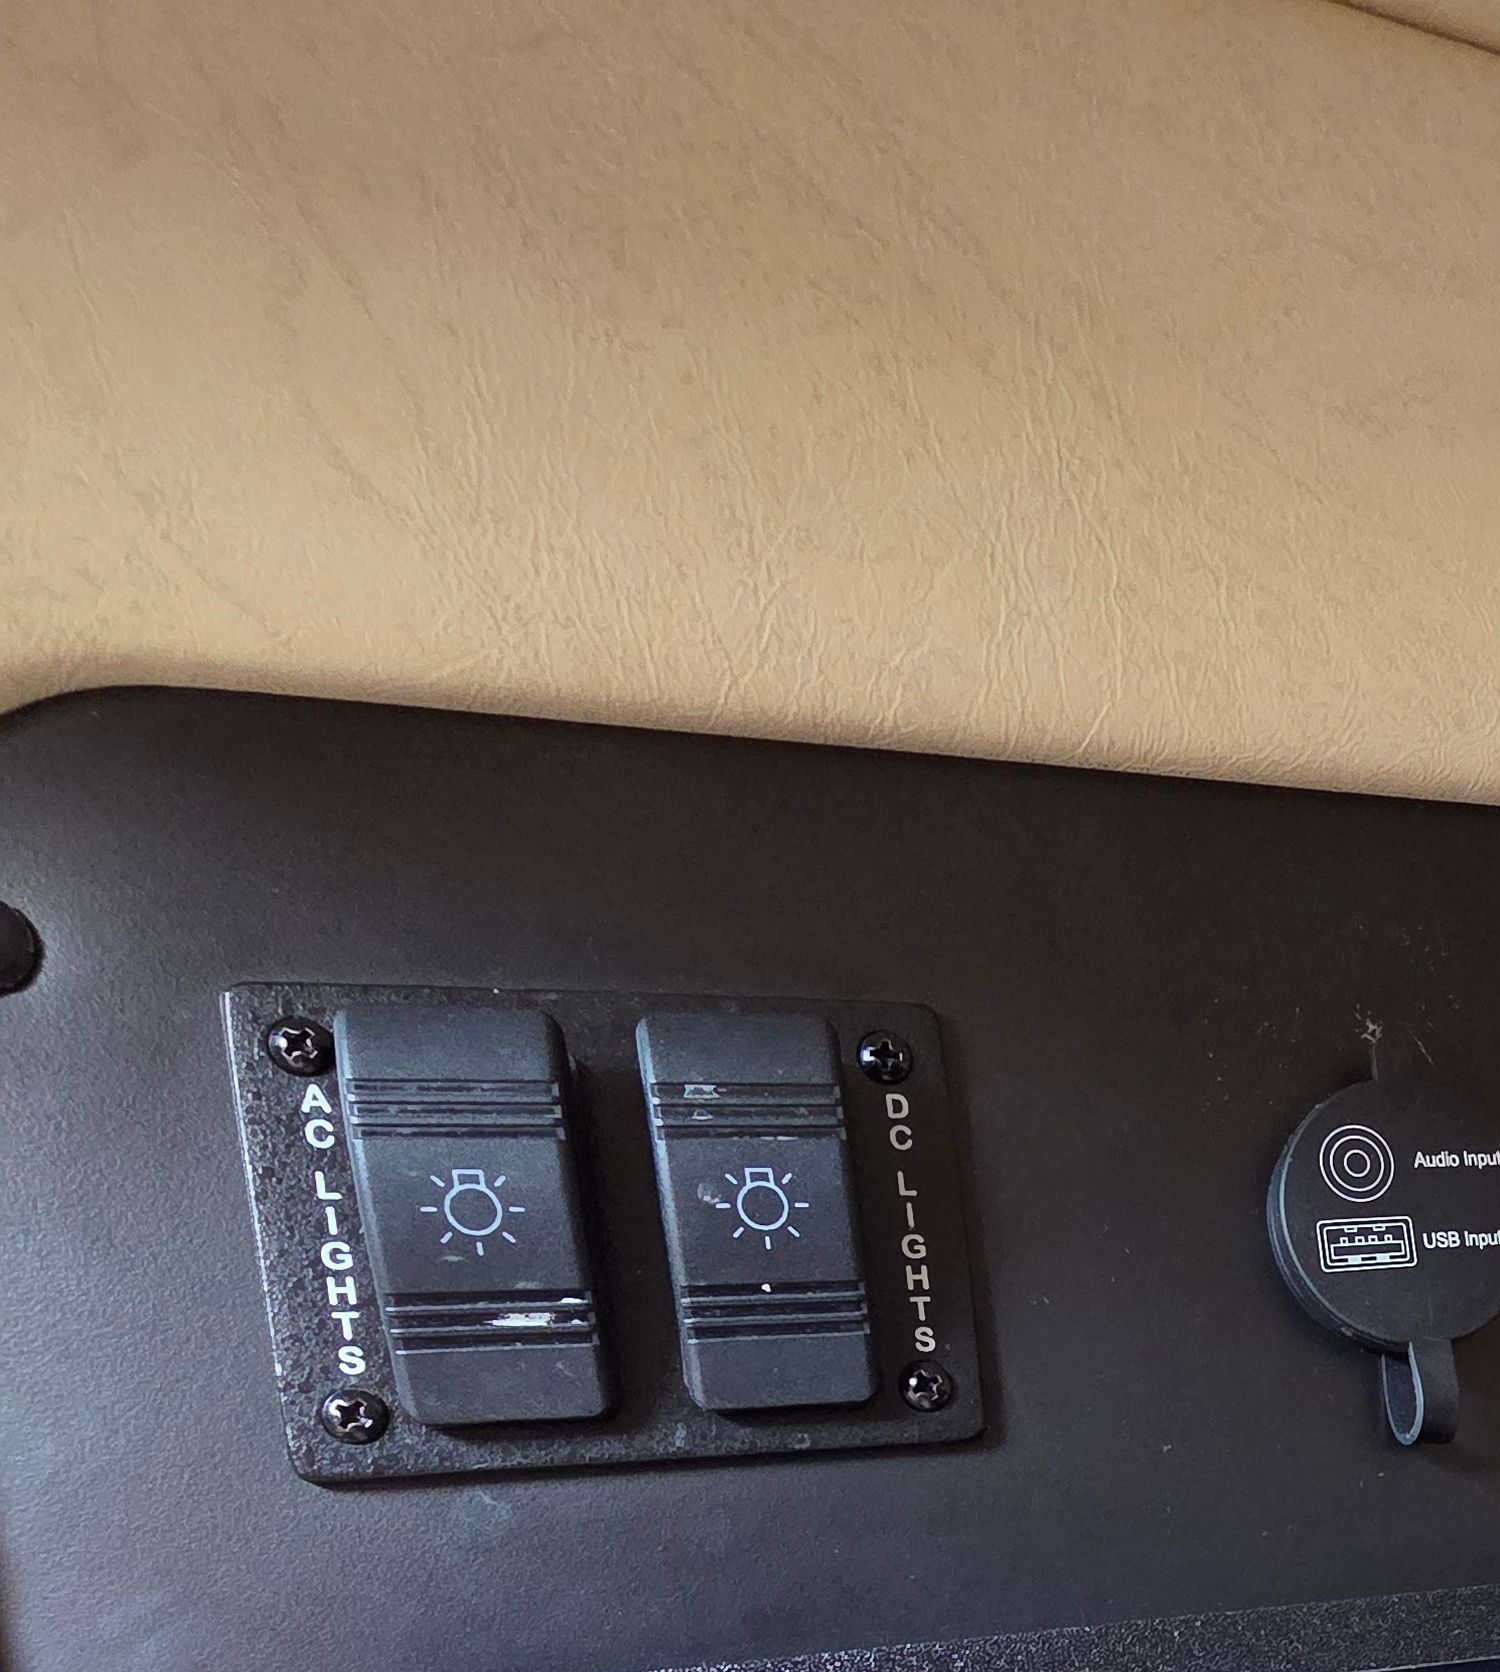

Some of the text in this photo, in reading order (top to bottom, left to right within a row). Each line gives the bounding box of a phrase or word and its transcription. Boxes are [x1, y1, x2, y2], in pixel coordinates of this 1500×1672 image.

[885, 1093, 936, 1353] DC LIGHTS
[1413, 1150, 1460, 1168] Audio
[301, 1083, 367, 1375] AC LIGHTS
[1422, 1231, 1460, 1248] USB
